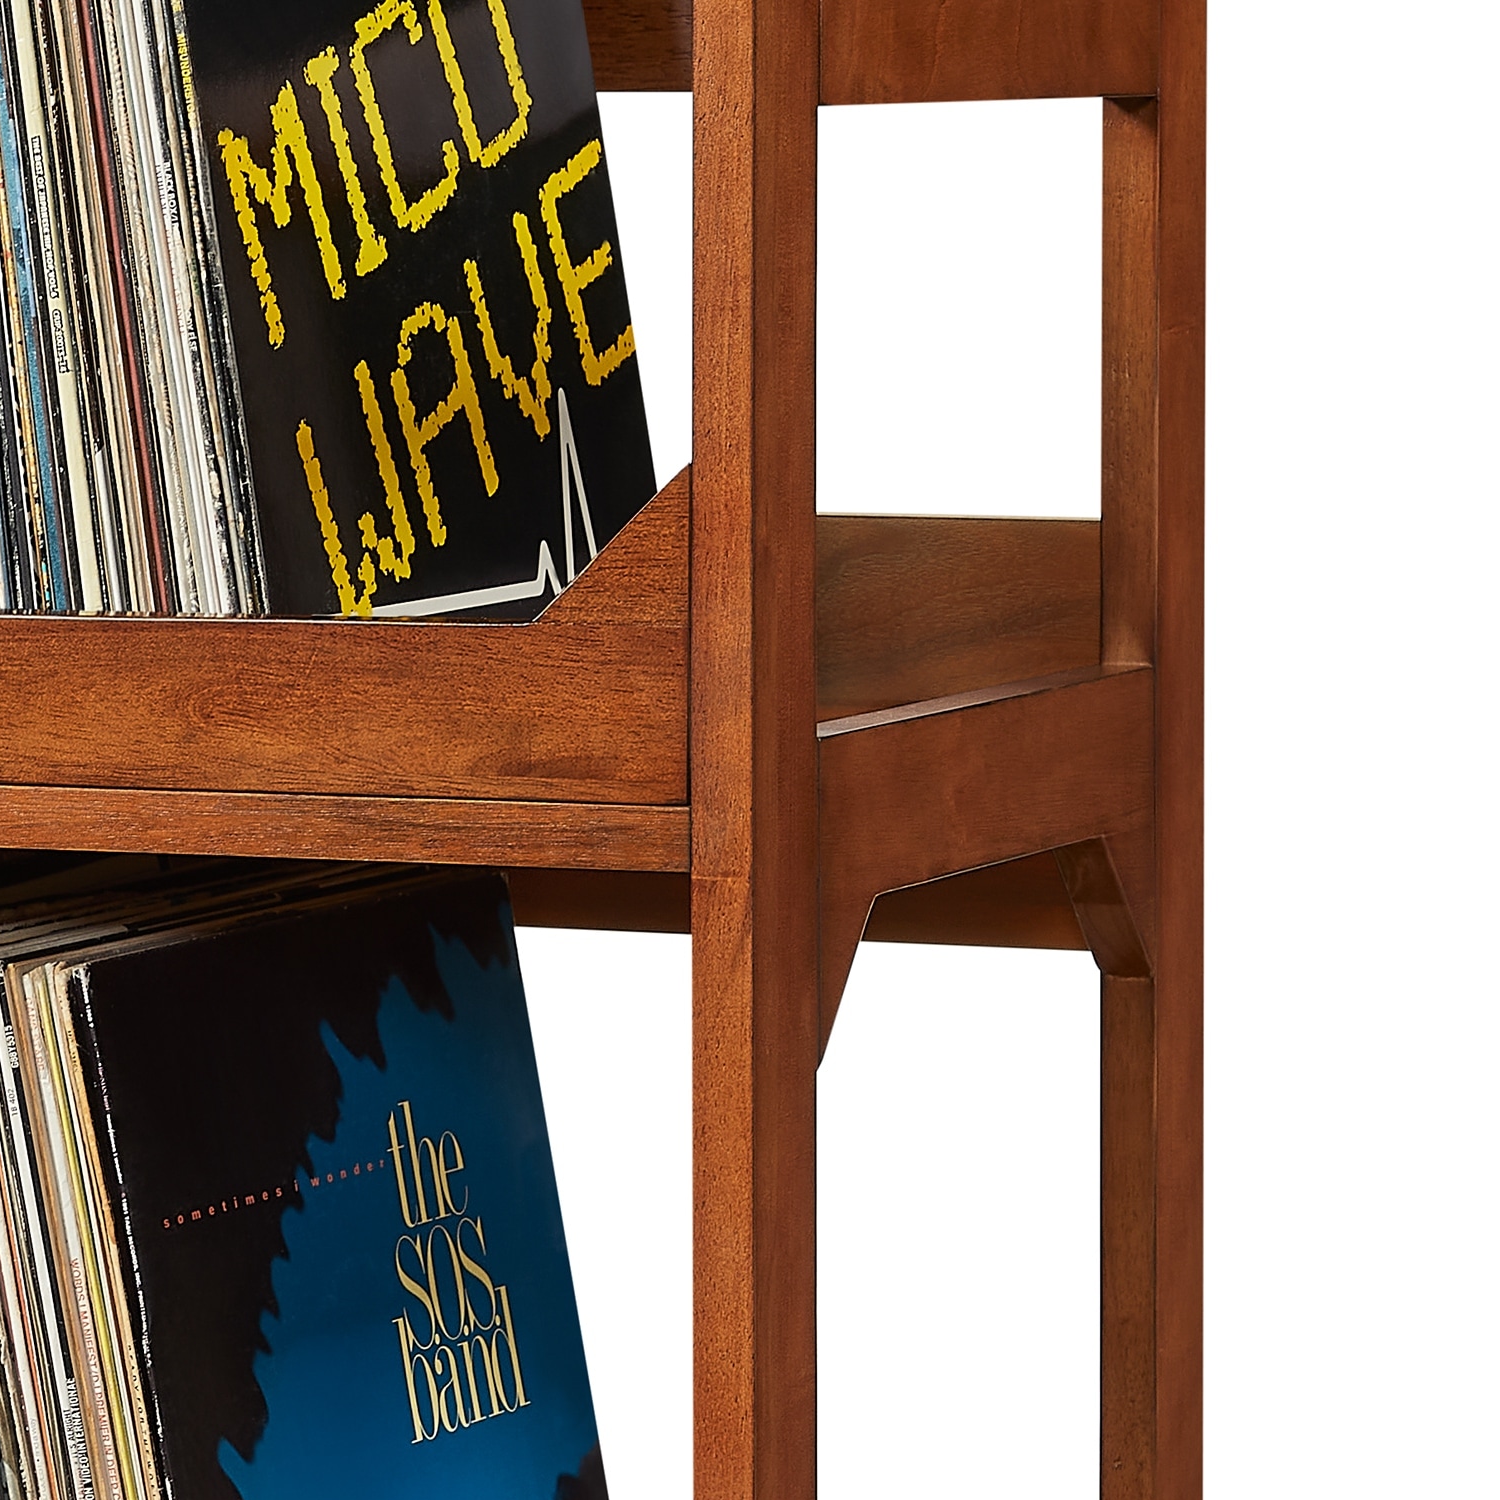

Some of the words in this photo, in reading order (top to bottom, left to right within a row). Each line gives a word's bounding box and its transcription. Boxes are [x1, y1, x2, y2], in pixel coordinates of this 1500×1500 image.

[296, 138, 636, 617] WAVE
[7, 1087, 16, 1104] 402
[387, 1101, 469, 1228] the
[162, 1185, 283, 1230] sometimes
[310, 1156, 386, 1190] wonder
[70, 1257, 86, 1301] WORDS
[392, 1285, 531, 1444] band
[62, 1407, 76, 1441] ALRIGHT
[67, 1376, 88, 1453] INTERNATIONAL
[93, 1392, 109, 1441] PREMIER
[79, 1457, 92, 1484] VIDEO
[102, 1443, 112, 1456] IN
[104, 1458, 118, 1490] DEEP
